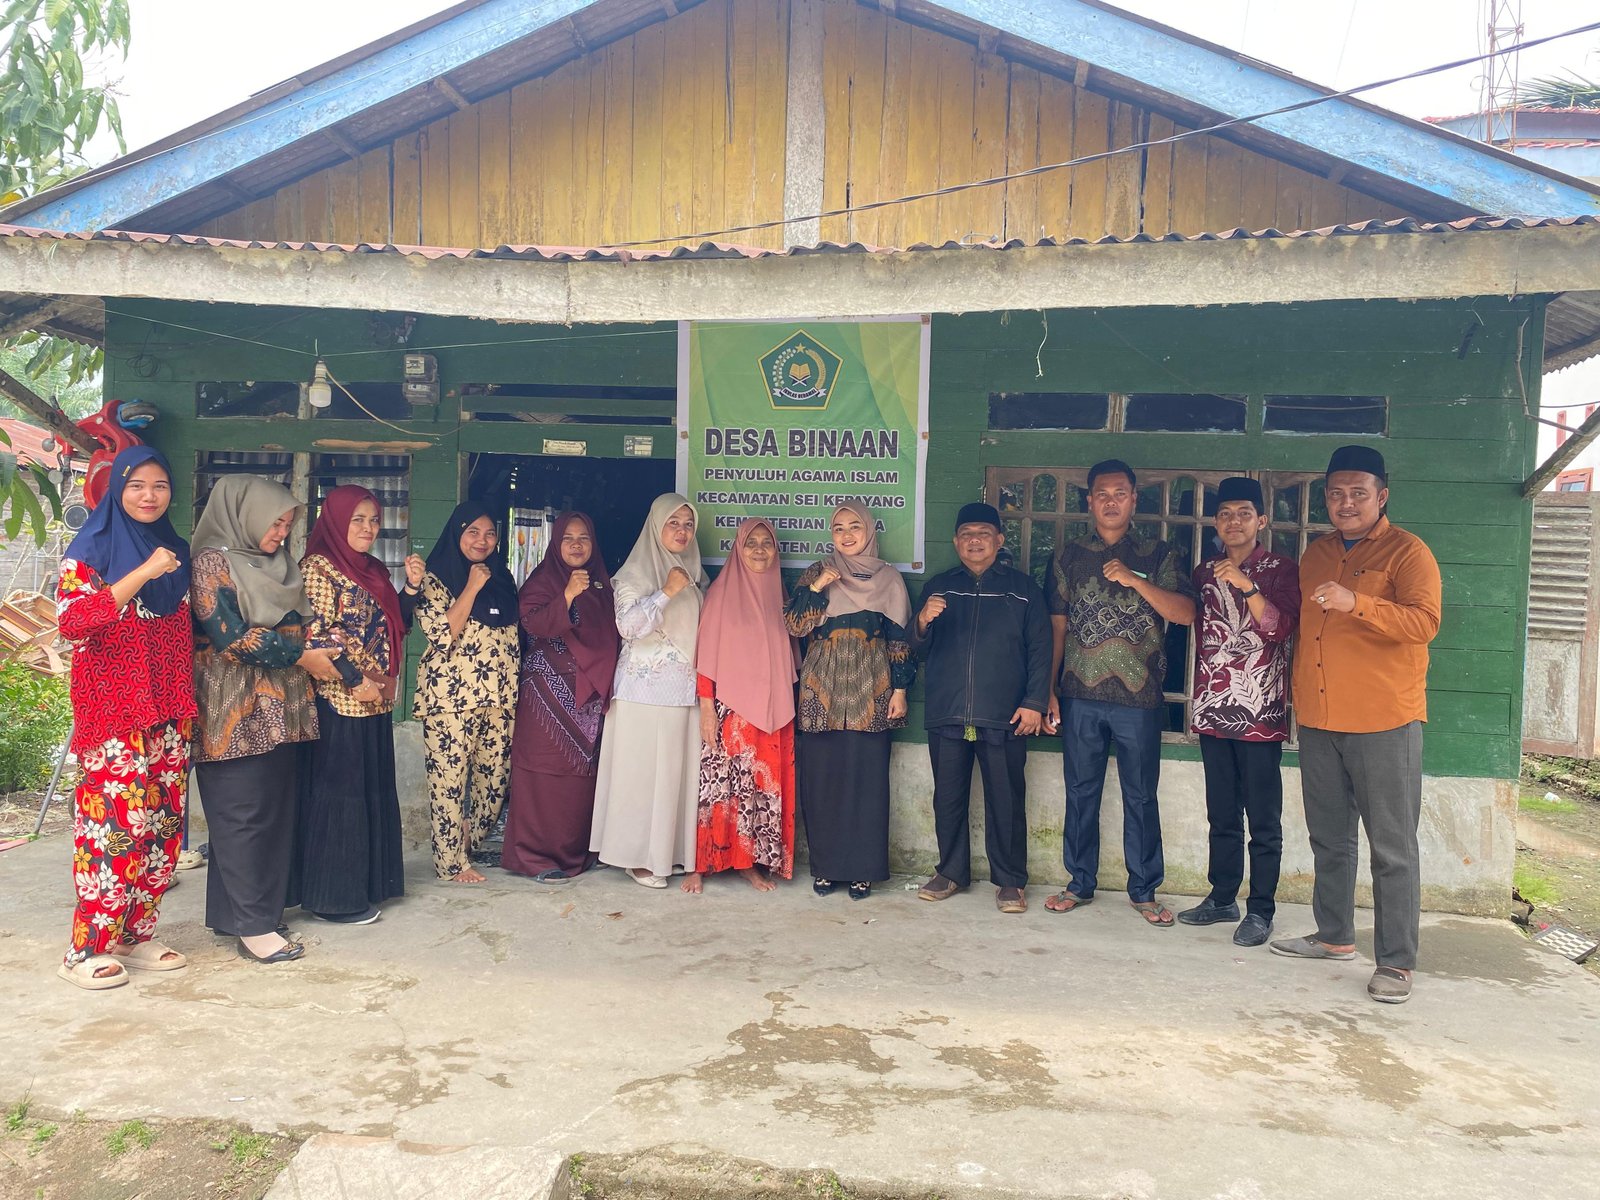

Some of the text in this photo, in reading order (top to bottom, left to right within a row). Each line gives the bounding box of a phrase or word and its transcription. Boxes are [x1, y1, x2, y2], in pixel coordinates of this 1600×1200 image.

[705, 428, 899, 459] DESA BINAAN
[704, 468, 898, 484] PENYULUH AGAMA ISLAM
[697, 491, 790, 505] KECAMATAN
[794, 494, 819, 506] SEI
[715, 515, 825, 530] KEMTERIAN
